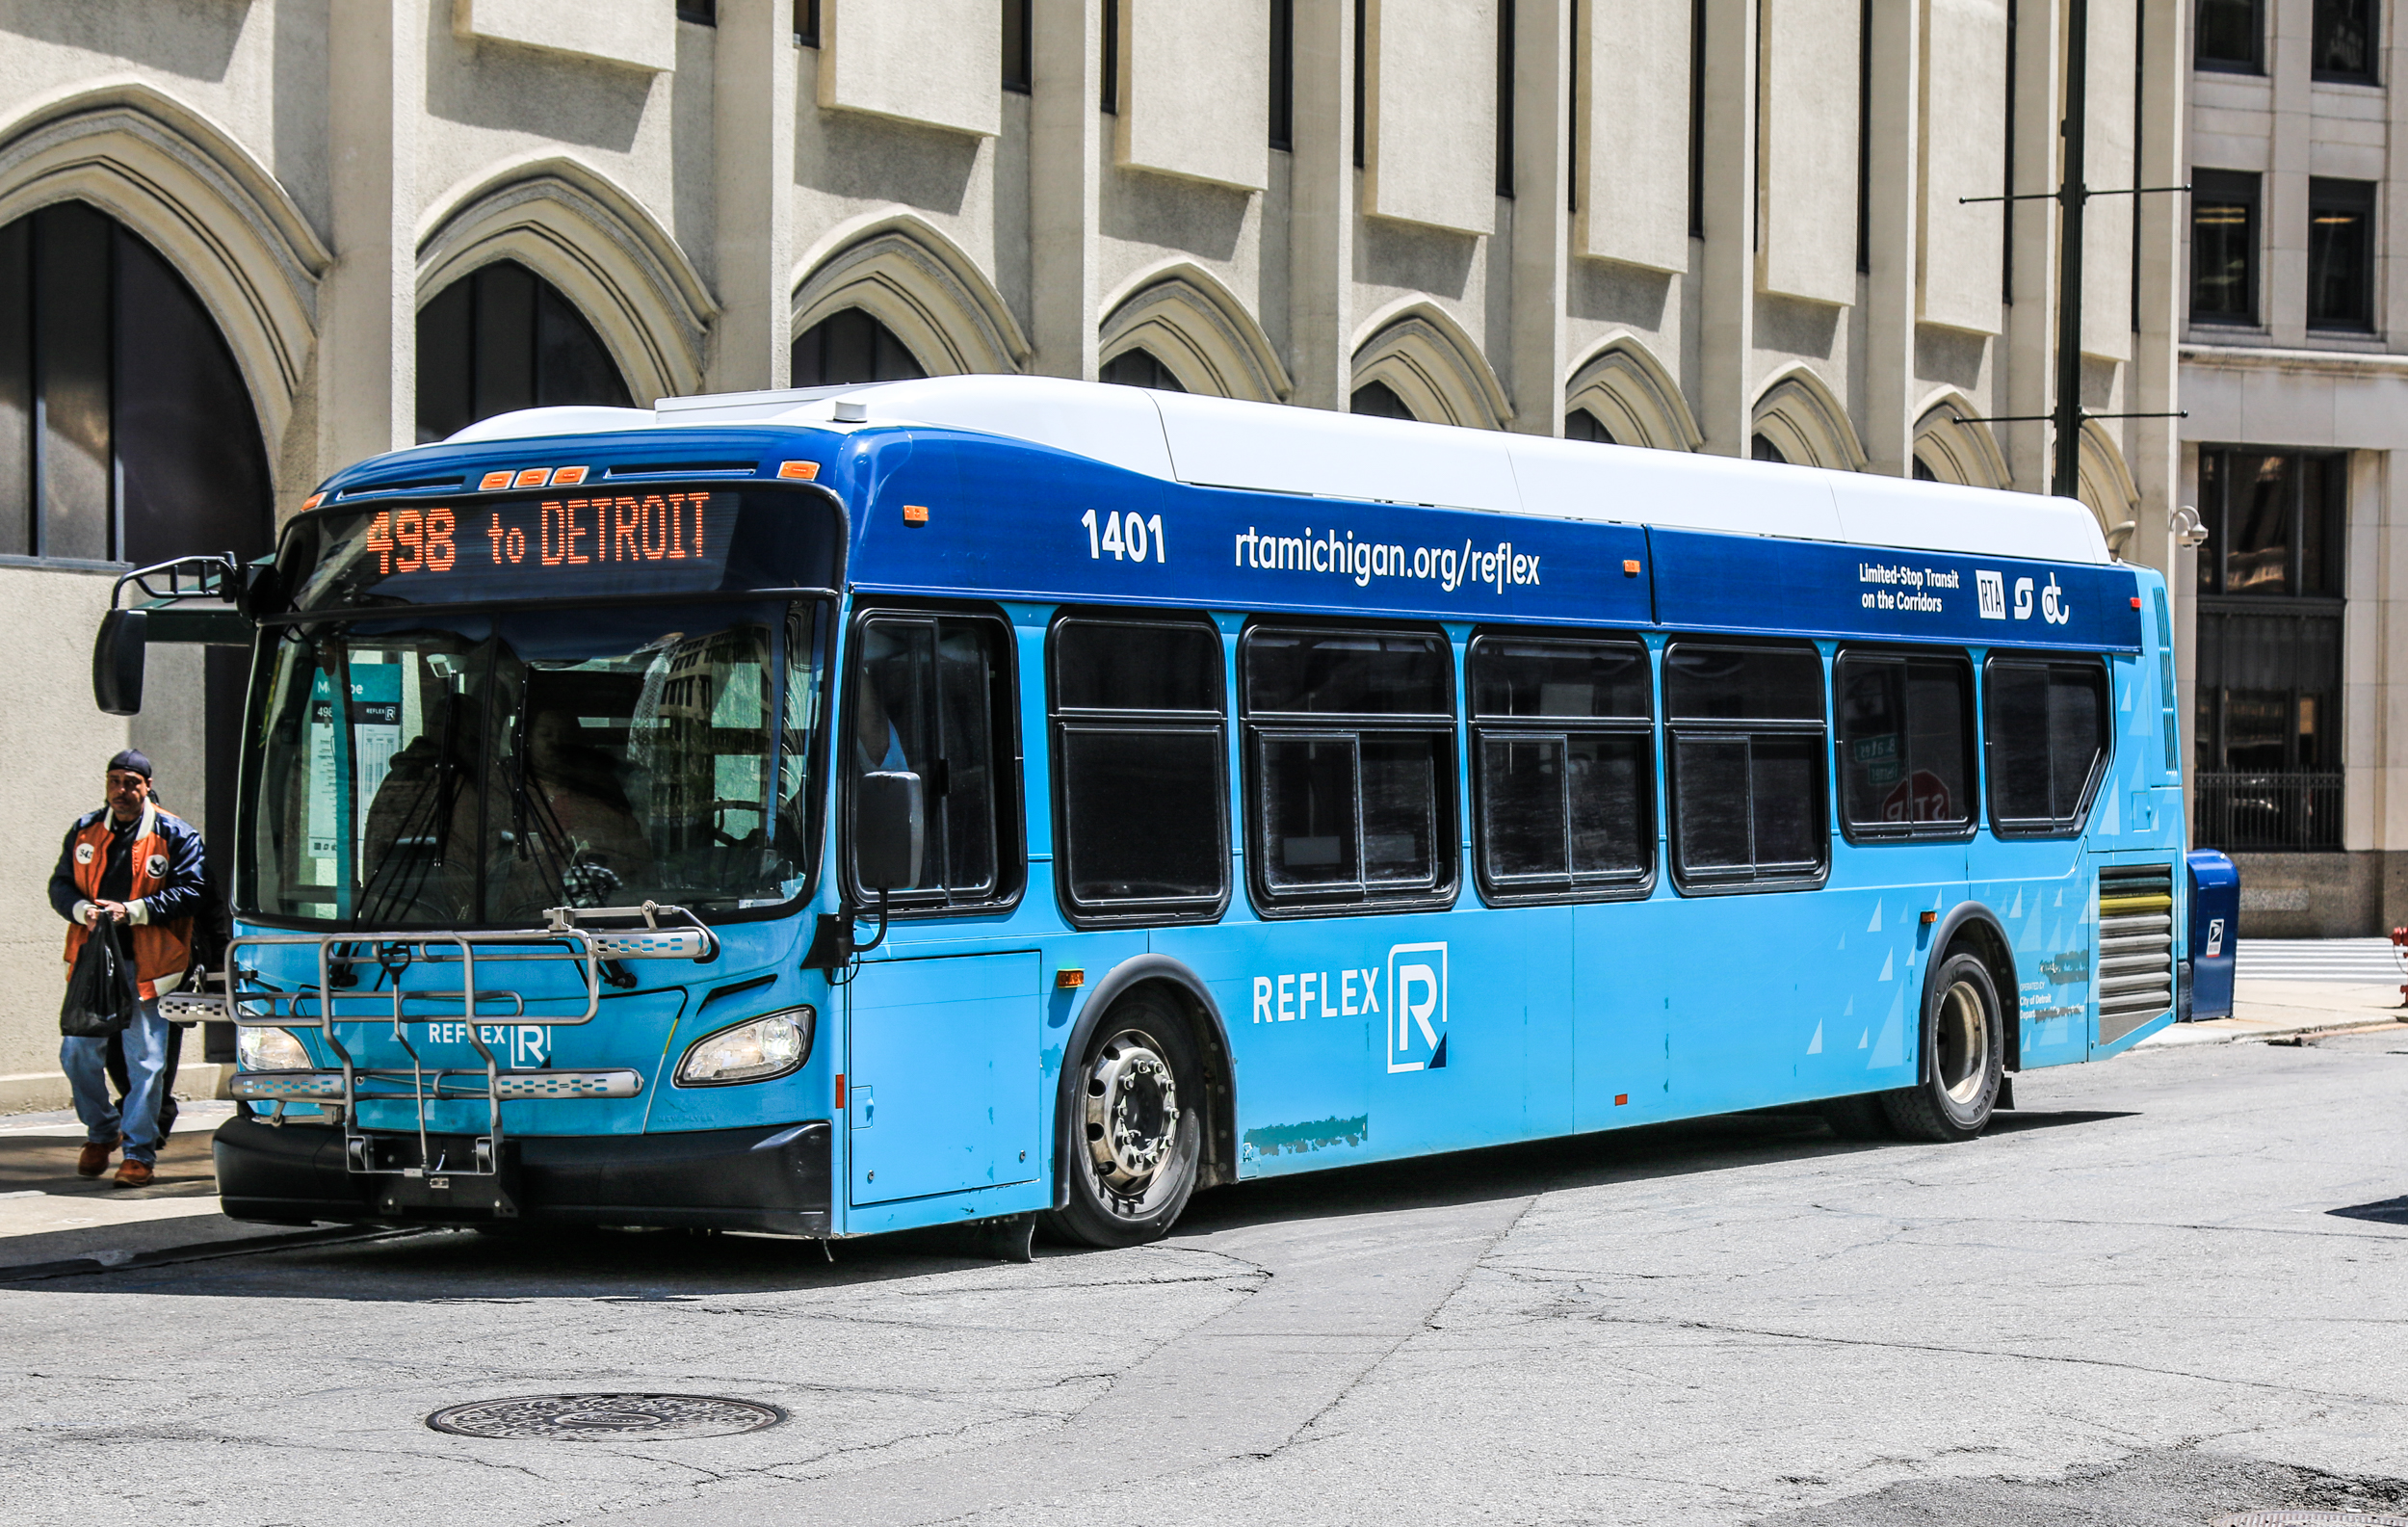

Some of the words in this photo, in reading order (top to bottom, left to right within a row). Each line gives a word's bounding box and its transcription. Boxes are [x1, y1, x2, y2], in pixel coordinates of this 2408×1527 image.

[367, 508, 456, 574] 498
[487, 513, 525, 565] to
[541, 492, 710, 566] DETROIT
[1081, 509, 1165, 564] 1401
[1235, 526, 1541, 594] rtamichigan.org/reflex
[1859, 563, 1924, 591] Limited-Stop
[1924, 568, 1959, 589] Transit
[1862, 592, 1874, 608] on
[1877, 590, 1894, 609] the
[1897, 591, 1943, 613] Corridors
[1980, 579, 2002, 613] RTA
[1253, 967, 1380, 1024] REFLEX
[1399, 964, 1438, 1051] R
[2020, 996, 2029, 1008] City
[2029, 995, 2035, 1005] of
[2035, 993, 2052, 1005] Detroit
[429, 1023, 506, 1043] REFEX
[518, 1025, 545, 1063] R
